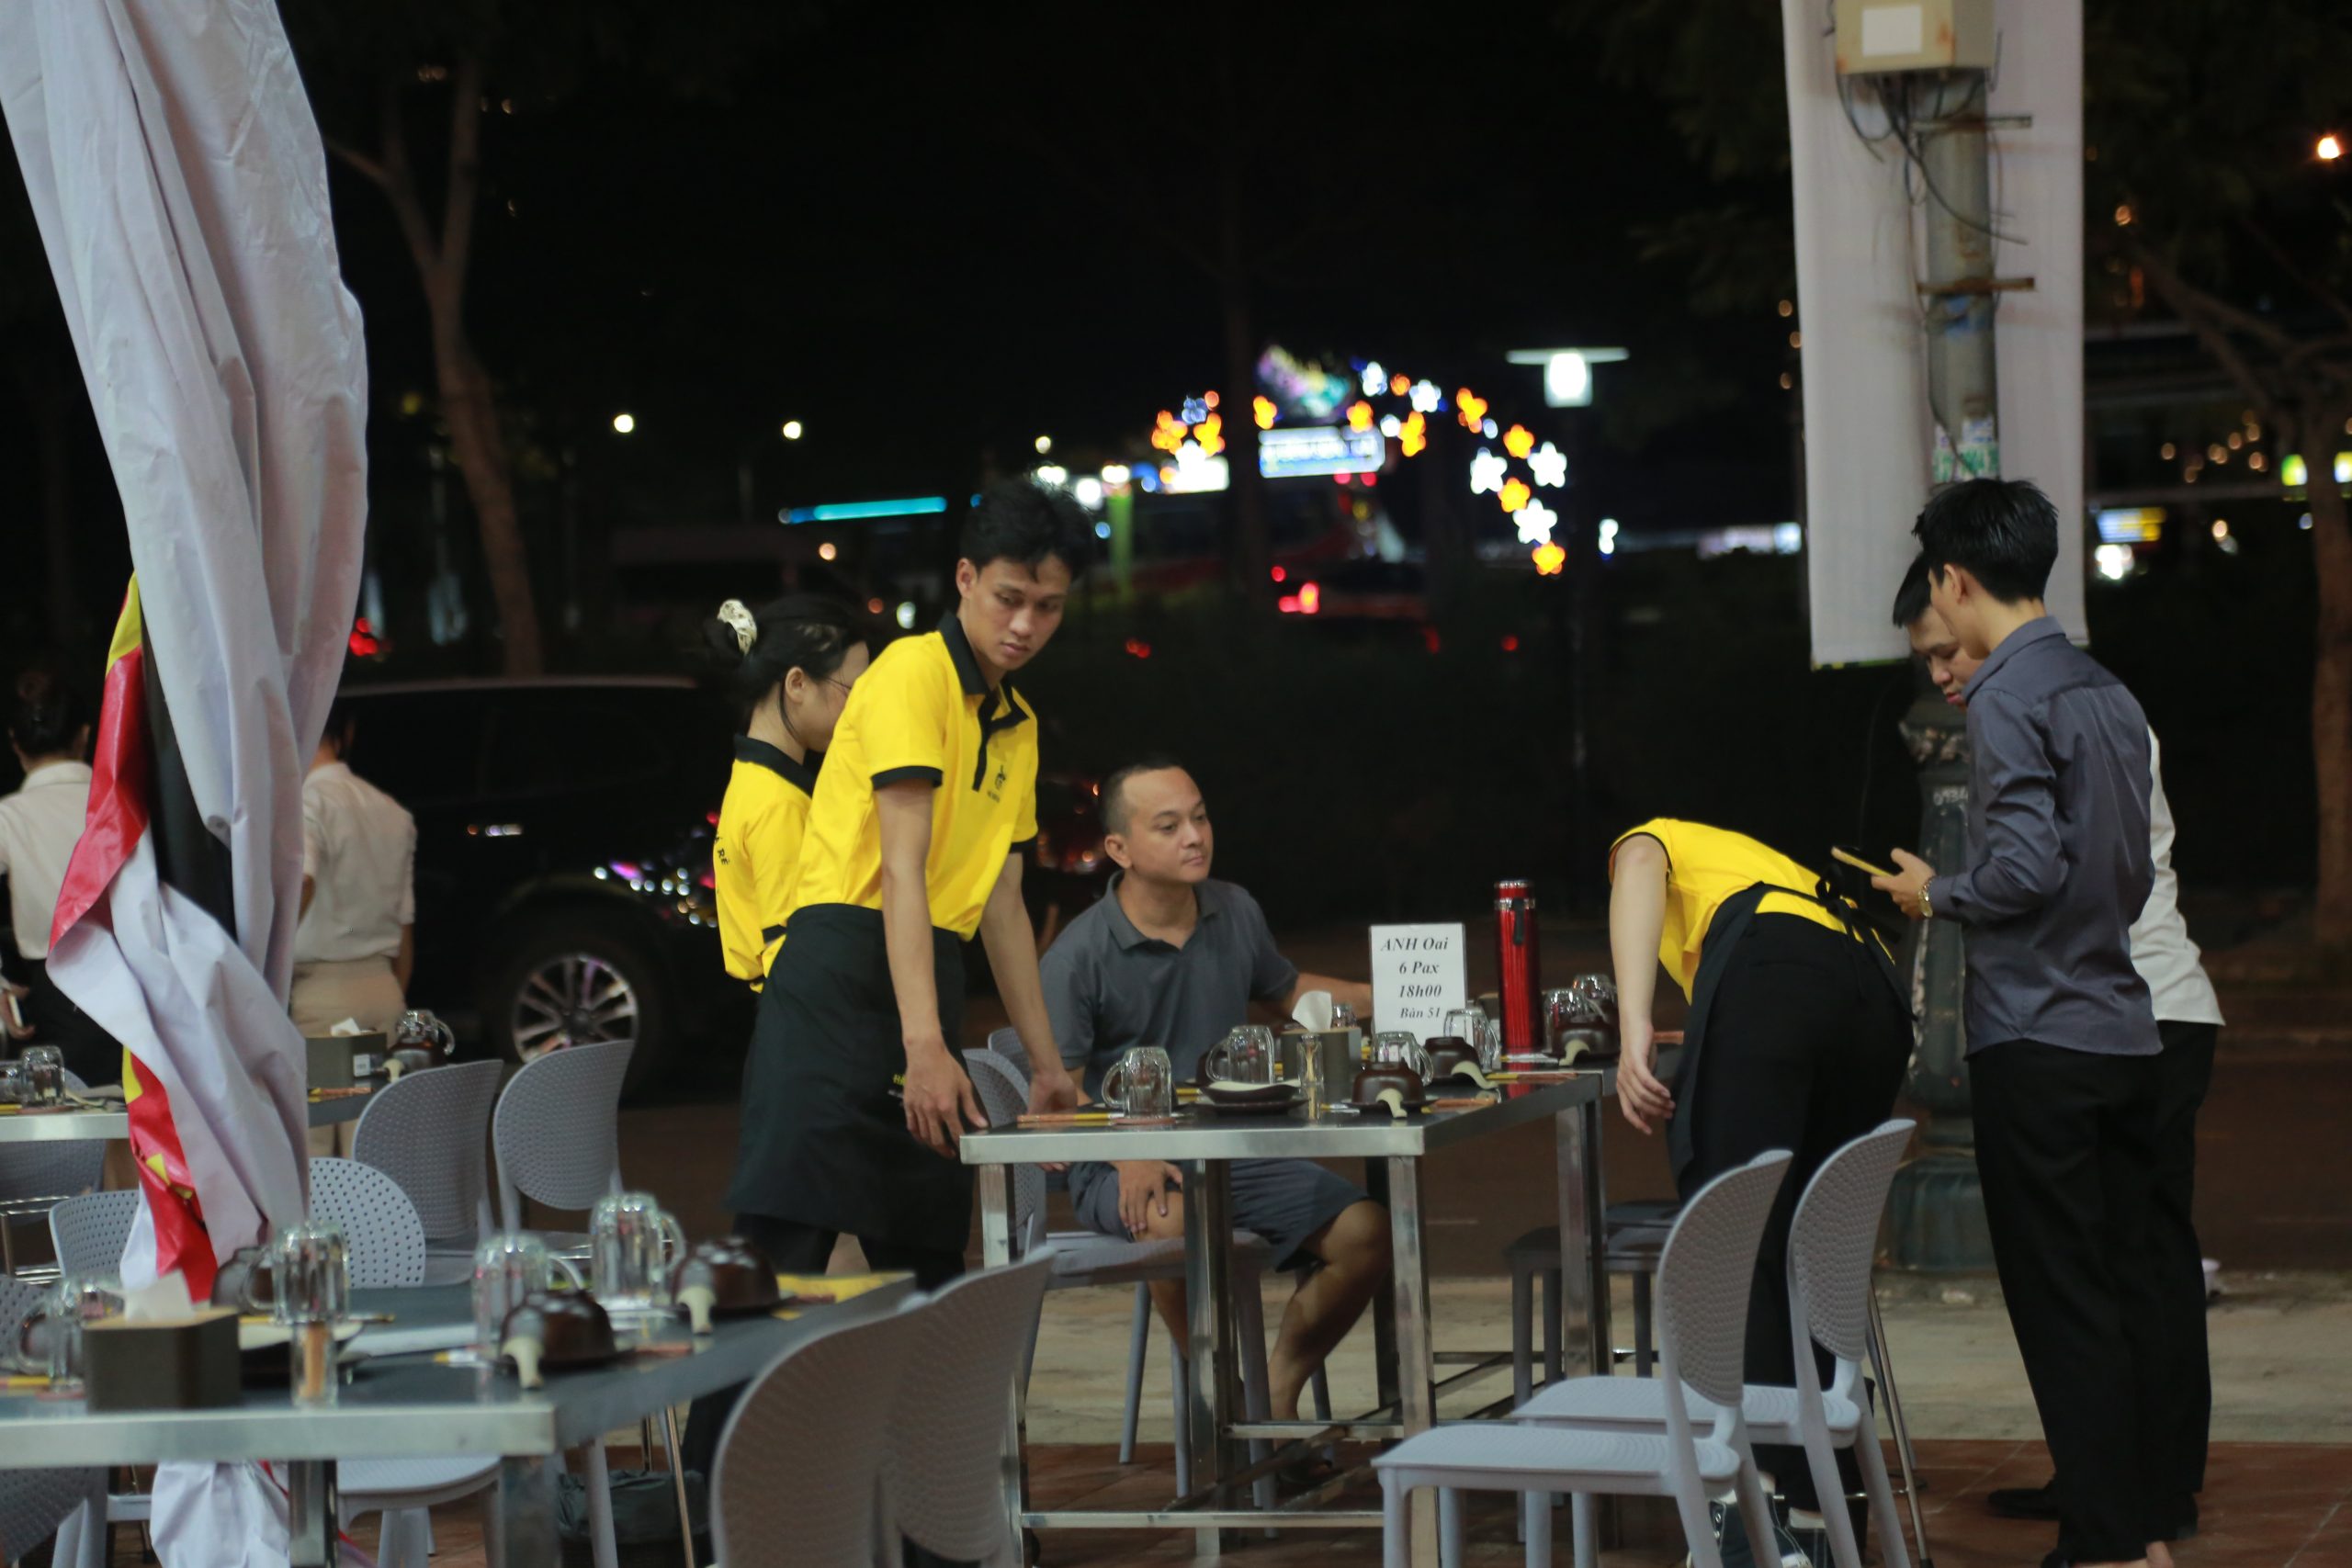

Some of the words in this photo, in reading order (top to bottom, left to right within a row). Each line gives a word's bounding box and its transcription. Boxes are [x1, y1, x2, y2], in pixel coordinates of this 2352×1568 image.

[1380, 937, 1418, 952] ANH
[1422, 936, 1449, 951] Oai
[1398, 961, 1408, 975] 6
[1412, 961, 1440, 975] Pax
[1399, 984, 1442, 998] 18h00
[1427, 1006, 1441, 1019] 51
